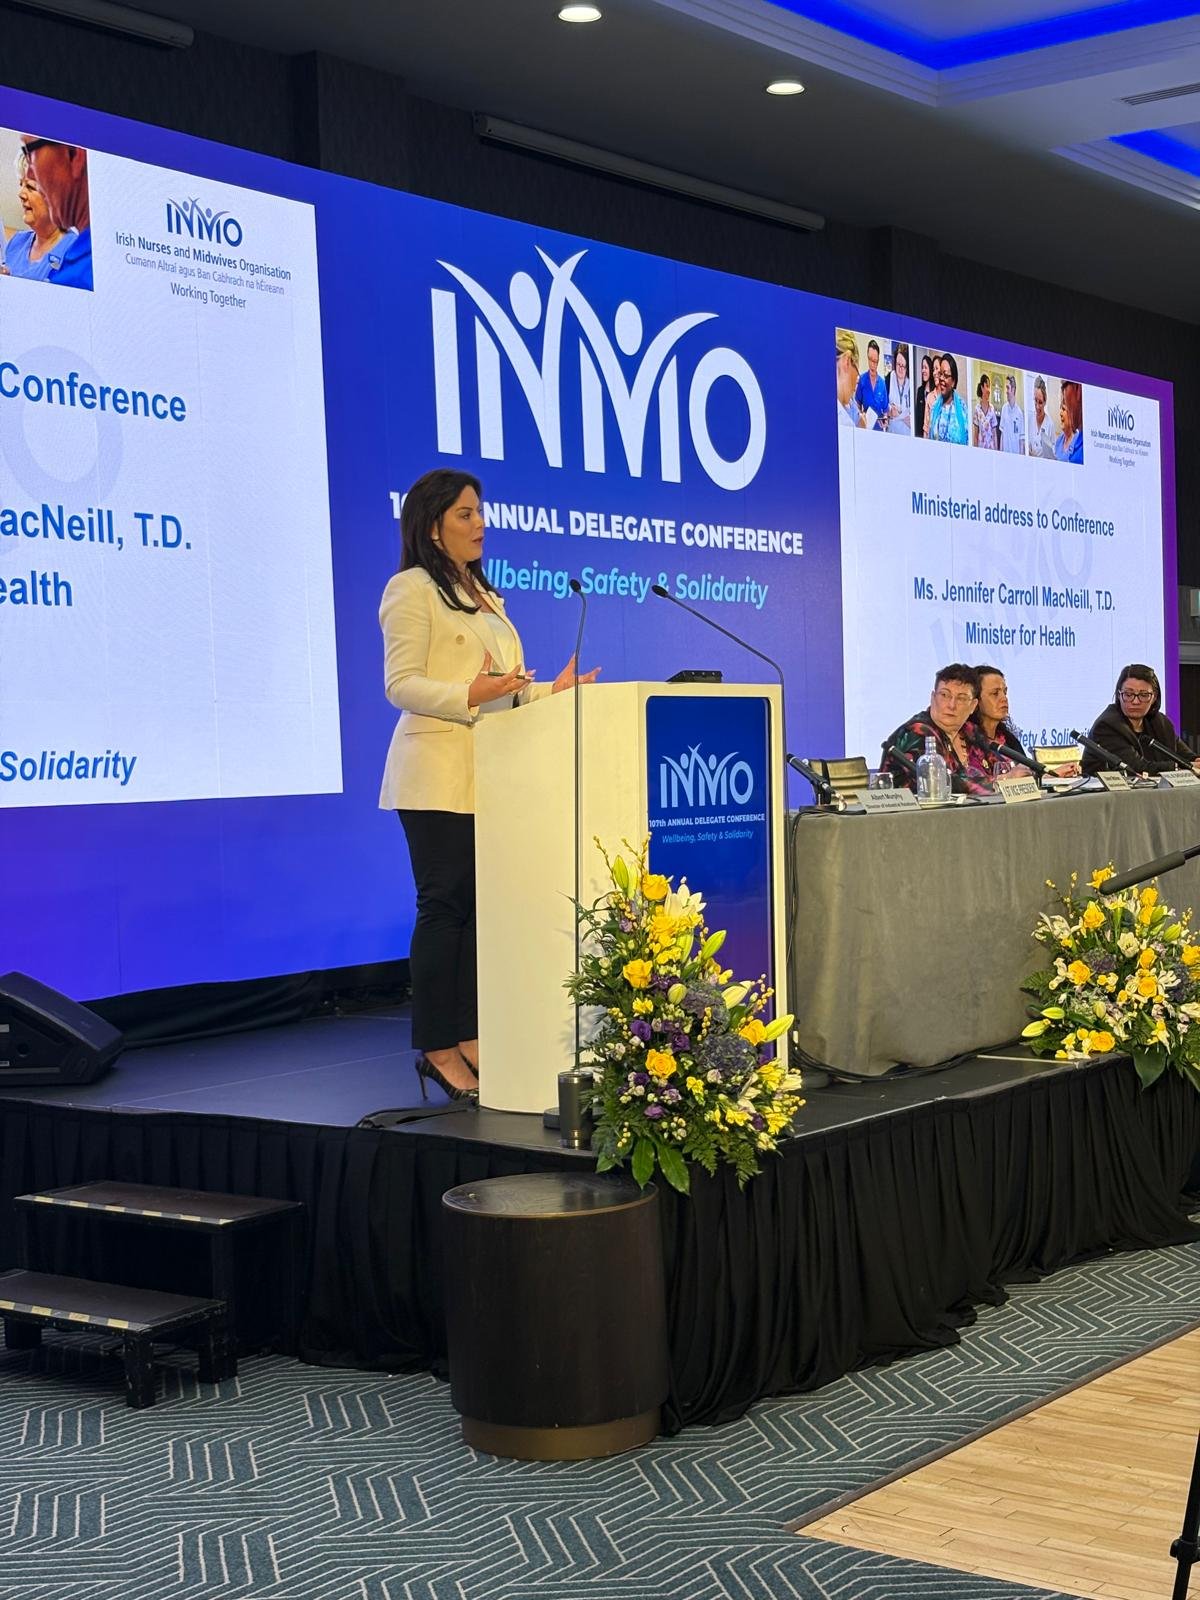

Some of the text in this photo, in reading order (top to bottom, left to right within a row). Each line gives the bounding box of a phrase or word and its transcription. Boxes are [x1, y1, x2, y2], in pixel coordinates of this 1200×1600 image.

[167, 196, 243, 247] INMO
[115, 231, 291, 281] Irish Nurses and Midwives Organisation
[178, 264, 196, 278] agus
[170, 281, 247, 309] Working Together
[431, 245, 767, 491] INMO
[0, 361, 188, 422] Conference
[1107, 404, 1135, 431] INMO
[0, 503, 192, 552] acNeill, T.D.
[483, 501, 804, 555] NNUAL DELEGATE CONFERENCE
[911, 491, 1115, 537] Ministerial address to Conference
[581, 567, 651, 604] Safety
[657, 572, 669, 592] &
[675, 572, 769, 610] Solidarity
[914, 576, 1116, 614] Ms. Jennifer Carroll MacNeill, T.D.
[966, 621, 1076, 648] Minister for Health
[1040, 728, 1048, 746] &
[0, 749, 137, 787] Solidarity
[660, 742, 754, 808] INMO
[649, 813, 765, 828] 107th ANNUAL DELEGATE CONFERENCE
[697, 831, 718, 842] Safety
[718, 831, 724, 840] &
[724, 829, 754, 840] Solidarity
